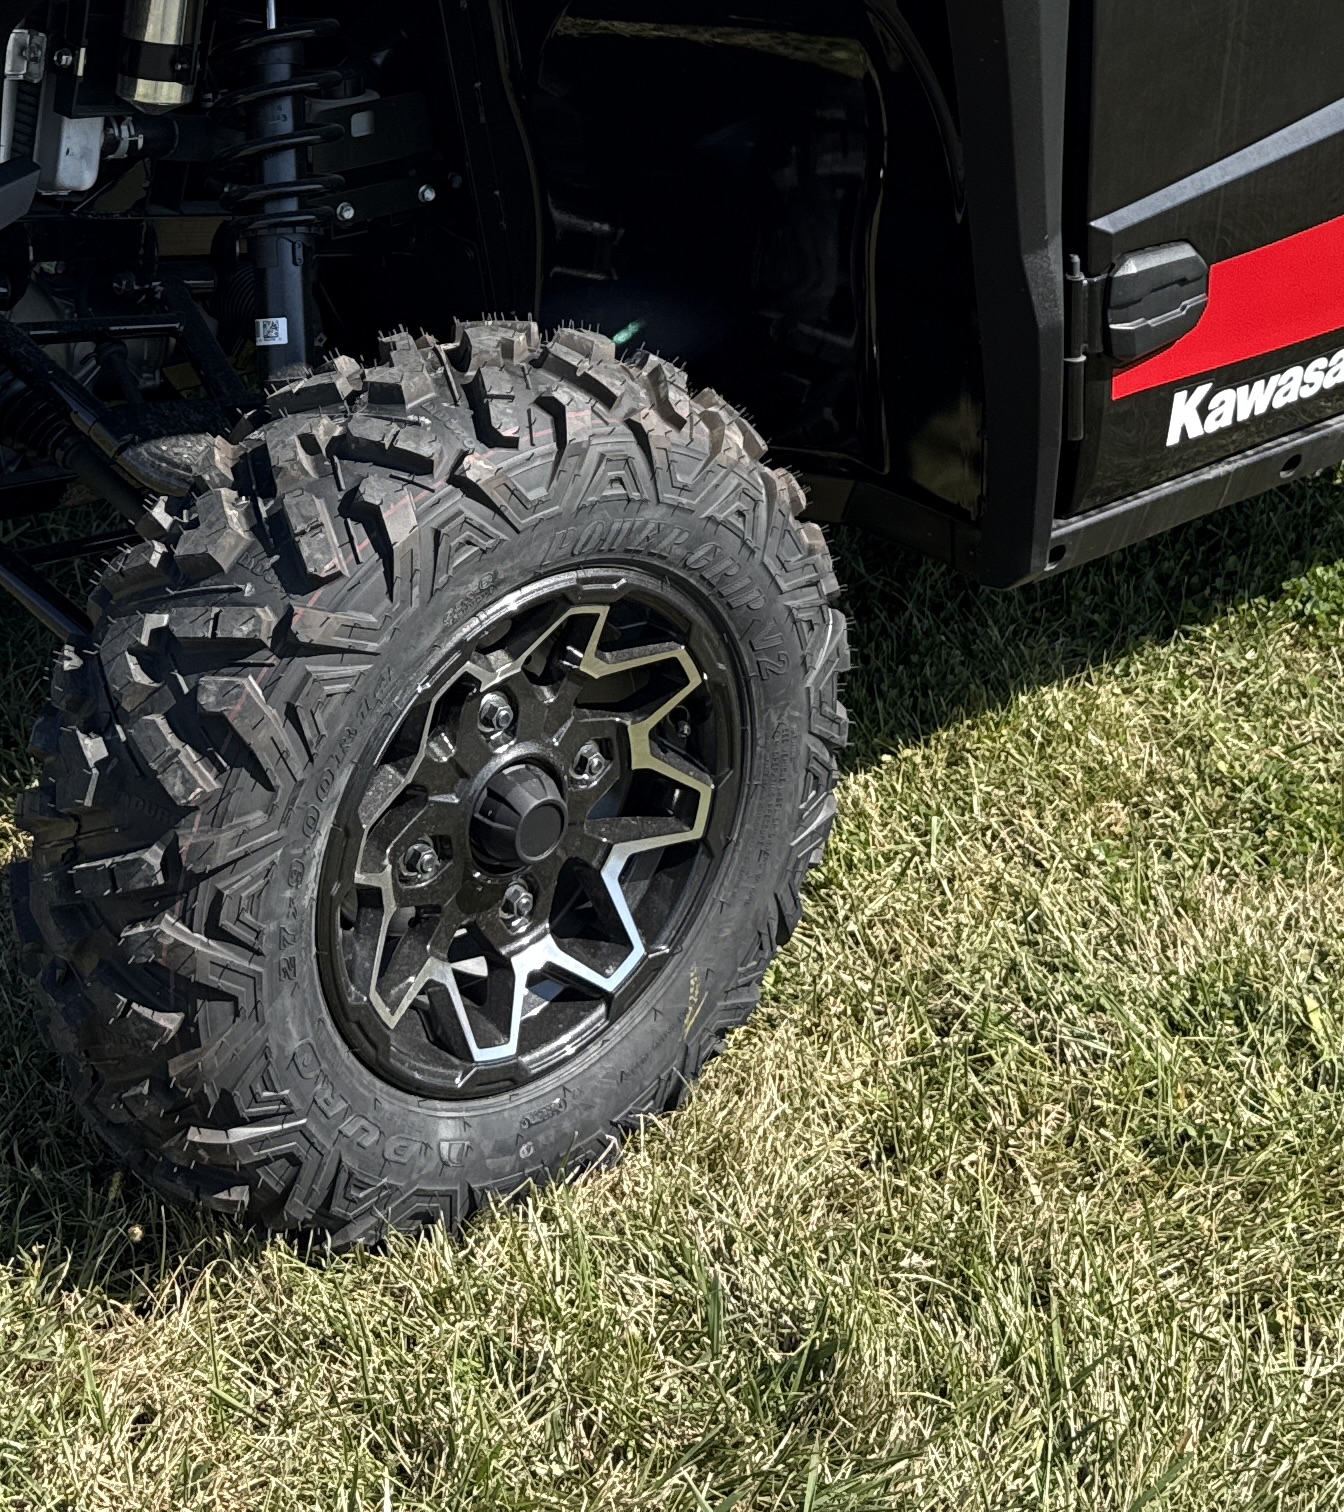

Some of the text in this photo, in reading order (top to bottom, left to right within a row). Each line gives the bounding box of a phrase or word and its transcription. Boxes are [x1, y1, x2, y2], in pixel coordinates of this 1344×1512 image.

[540, 519, 790, 681] POWER GRIP V2
[293, 1038, 426, 1167] DURO
